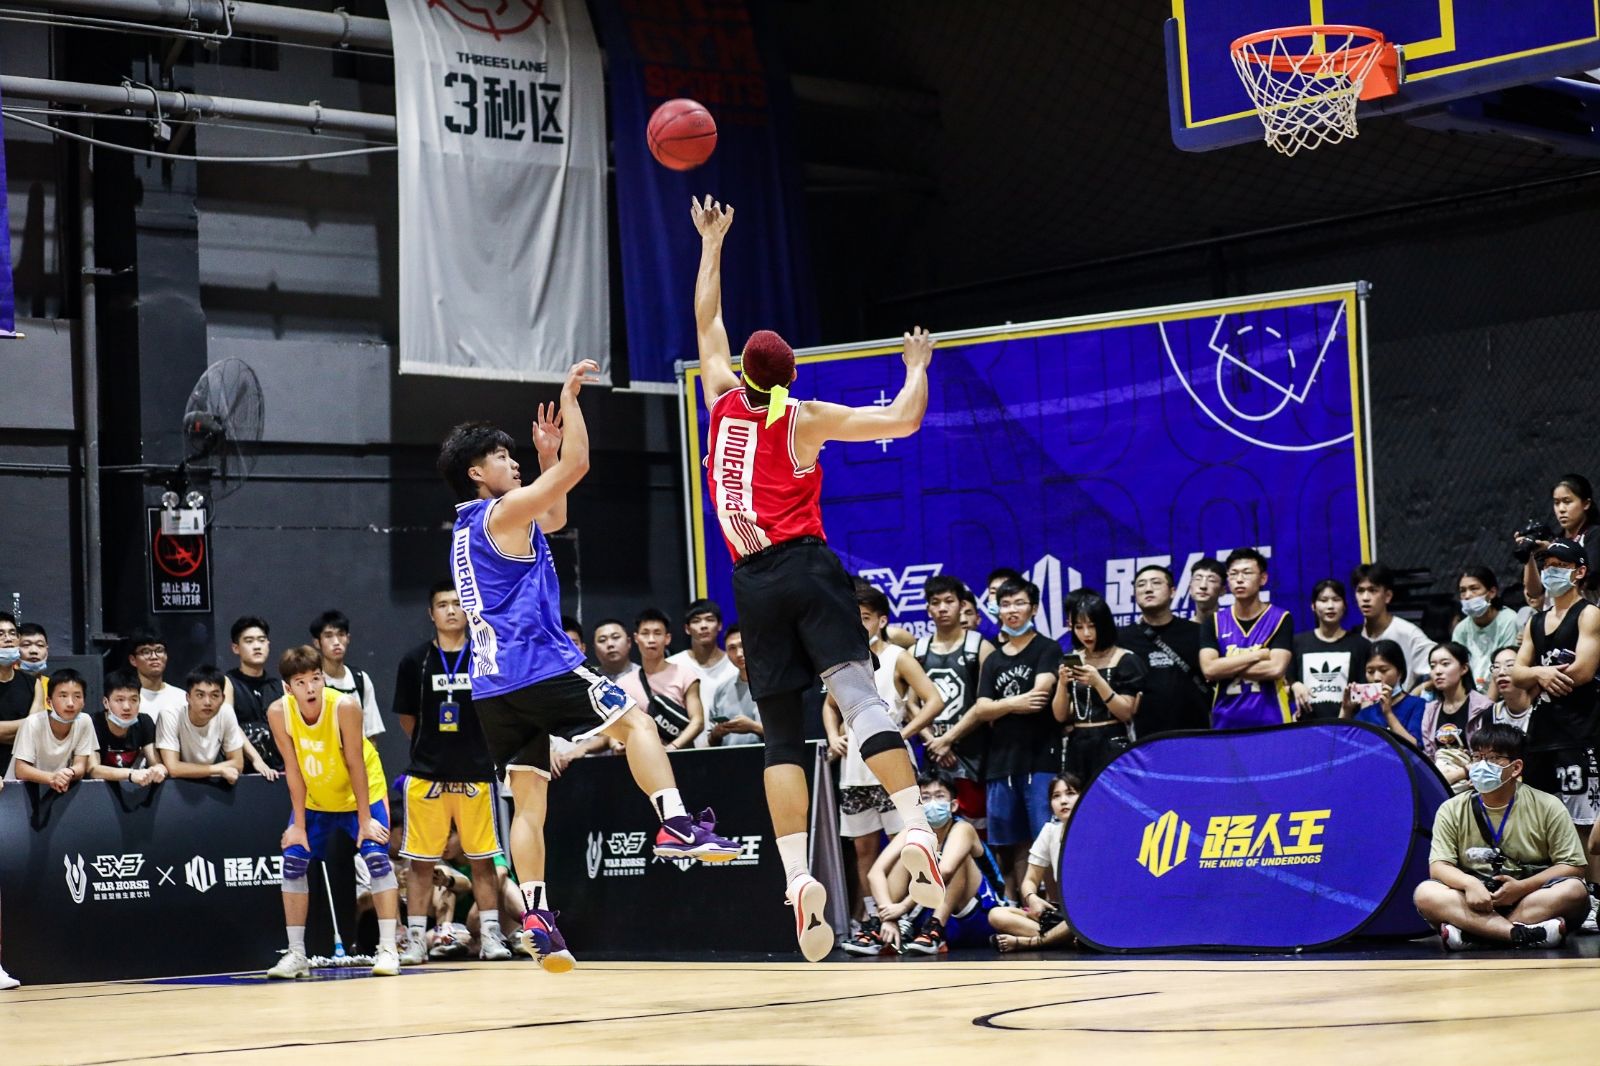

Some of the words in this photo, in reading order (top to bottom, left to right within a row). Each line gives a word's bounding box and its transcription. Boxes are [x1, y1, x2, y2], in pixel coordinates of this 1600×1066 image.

[456, 52, 509, 69] THREES
[512, 59, 548, 73] LANE
[444, 72, 564, 144] 3秒区
[161, 582, 200, 594] 禁止暴力
[162, 595, 201, 606] 文明打球
[1113, 615, 1131, 627] HE
[1310, 684, 1342, 692] adidas
[654, 714, 680, 736] ADID
[1556, 764, 1584, 791] 23
[1200, 809, 1331, 859] 路人王
[1199, 860, 1218, 869] THE
[1219, 859, 1243, 868] KING
[1245, 858, 1259, 867] OF
[1261, 855, 1321, 866] UNDERDOGS
[92, 881, 115, 891] WAR
[115, 880, 149, 891] HORSE
